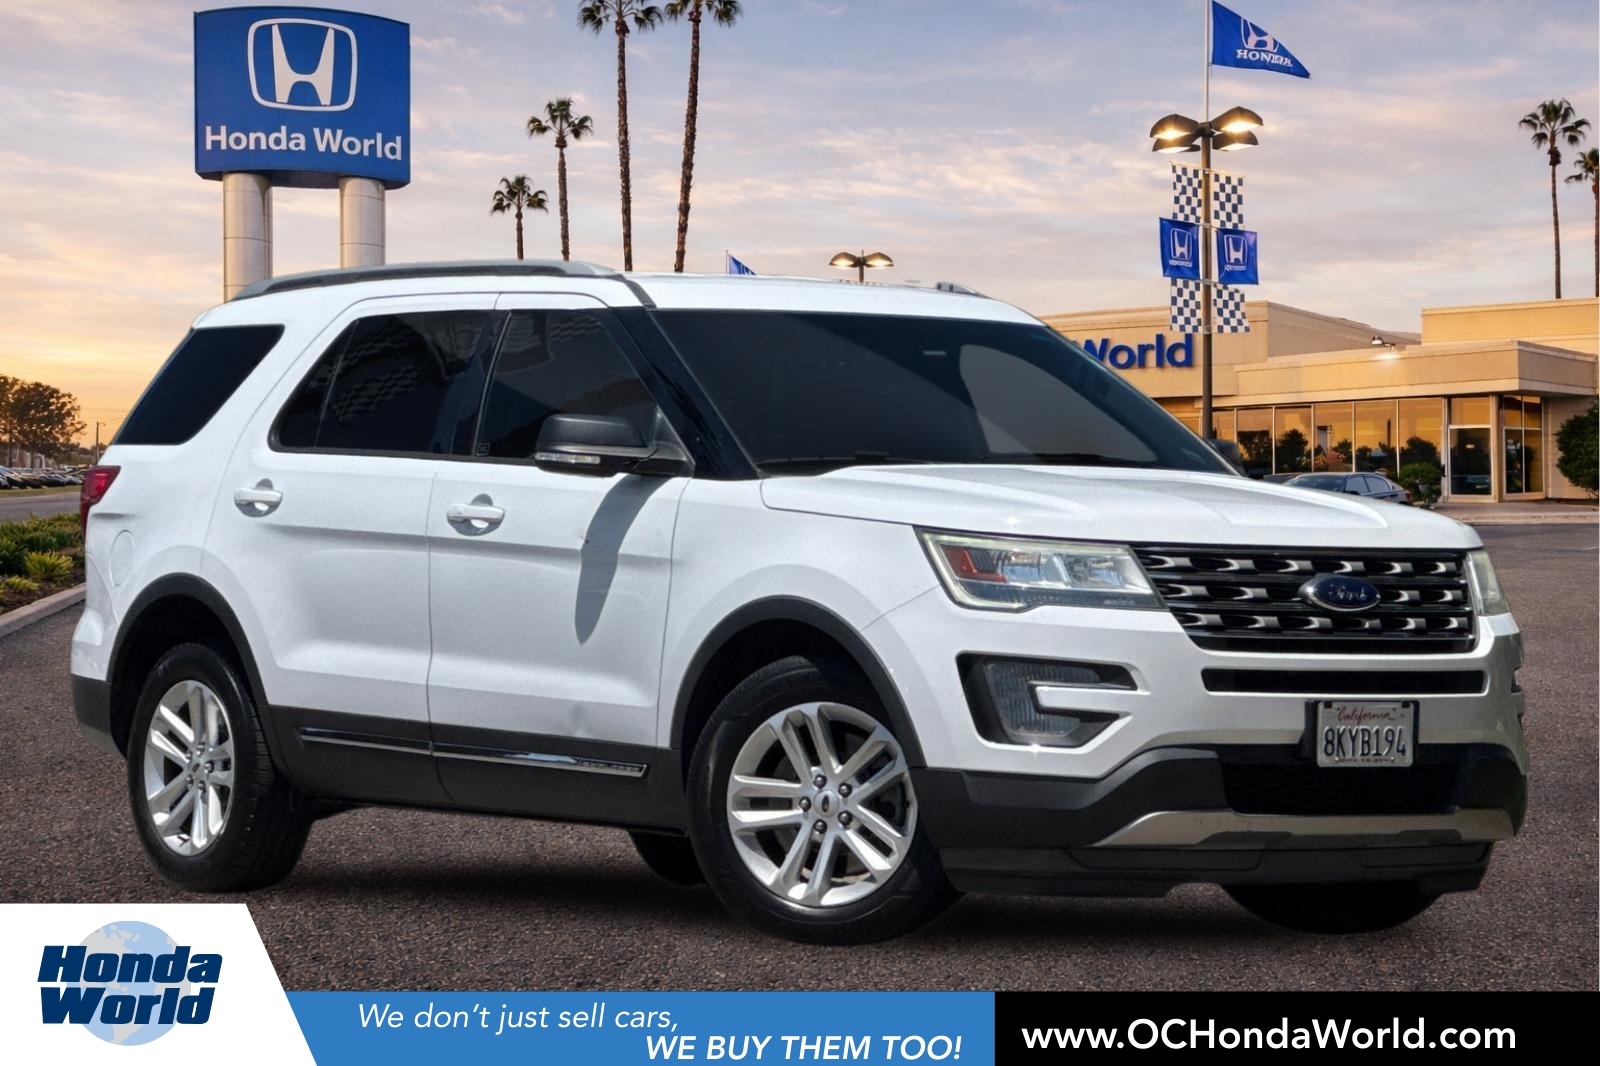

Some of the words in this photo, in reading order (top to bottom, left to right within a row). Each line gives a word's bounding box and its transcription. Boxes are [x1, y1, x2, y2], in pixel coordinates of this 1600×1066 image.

[205, 125, 306, 151] Honda
[312, 127, 402, 161] World
[1337, 706, 1395, 725] California
[1323, 726, 1406, 757] 8KYB194
